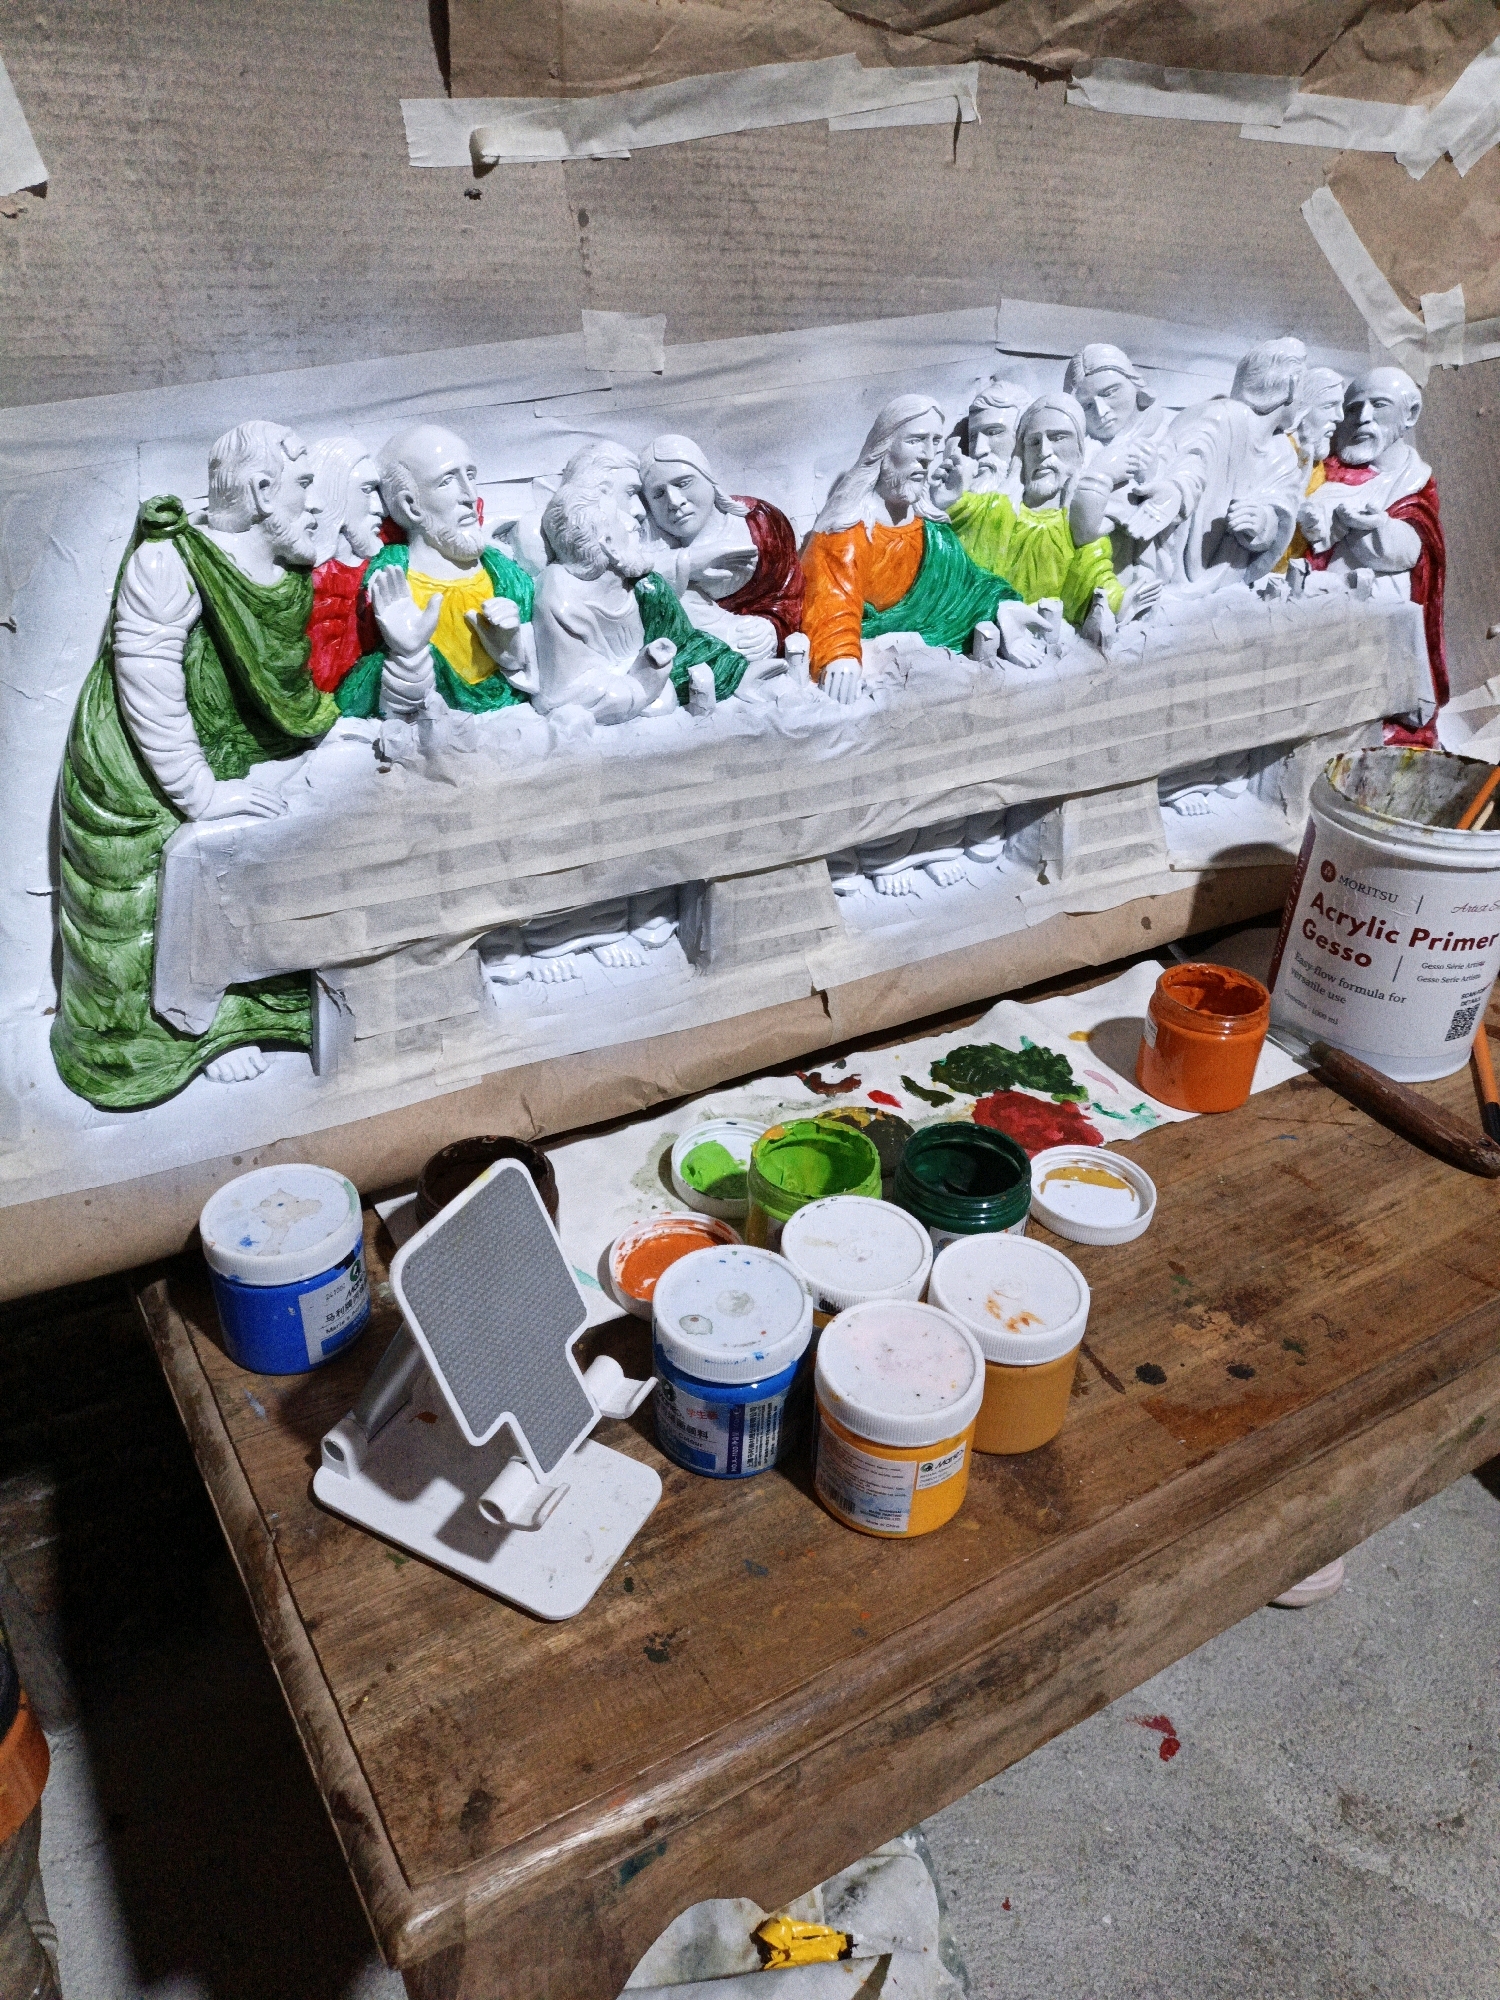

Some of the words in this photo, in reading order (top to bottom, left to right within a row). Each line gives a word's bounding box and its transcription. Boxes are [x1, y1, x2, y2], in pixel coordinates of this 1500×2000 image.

[1338, 875, 1398, 903] MORITSU
[1310, 892, 1400, 944] Acrylic
[1409, 927, 1500, 952] Primer
[1451, 902, 1489, 914] Artist
[1302, 918, 1372, 968] Gesso
[1291, 967, 1326, 996] versatile
[1327, 991, 1347, 1004] use
[1294, 951, 1337, 983] Easy-flow
[1338, 977, 1385, 1000] formula
[1388, 992, 1407, 1004] for
[1416, 975, 1440, 983] Gesso
